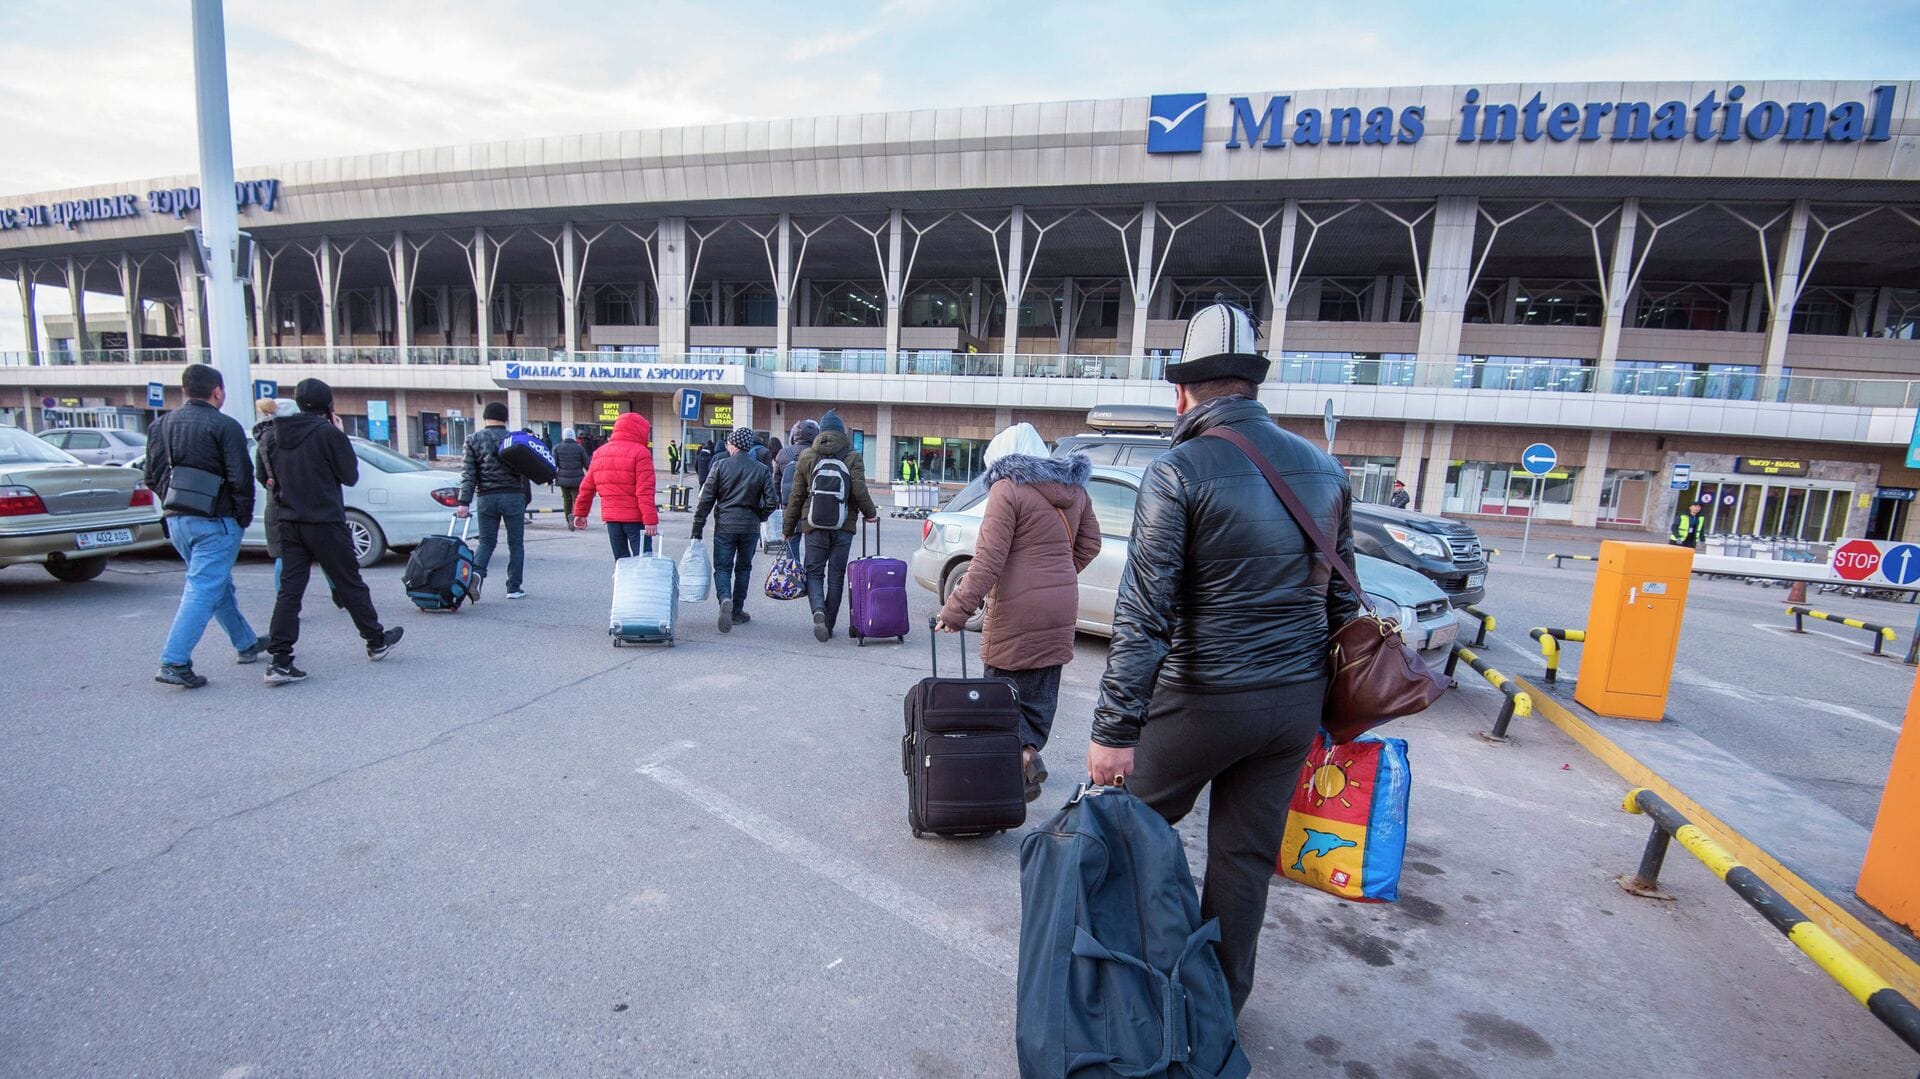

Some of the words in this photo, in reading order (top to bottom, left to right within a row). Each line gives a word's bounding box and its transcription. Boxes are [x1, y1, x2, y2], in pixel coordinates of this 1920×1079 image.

[1226, 96, 1426, 149] Manas
[1456, 84, 1897, 143] international
[50, 194, 139, 231] аралык
[147, 179, 278, 220] аэрорту
[521, 366, 566, 377] МАНАС
[568, 367, 585, 378] ЭЛ
[590, 367, 642, 379] АРАЛЫК
[646, 367, 724, 380] АЭРОПОРТУ
[259, 384, 273, 400] P
[685, 394, 697, 415] P
[1835, 551, 1879, 569] STOP
